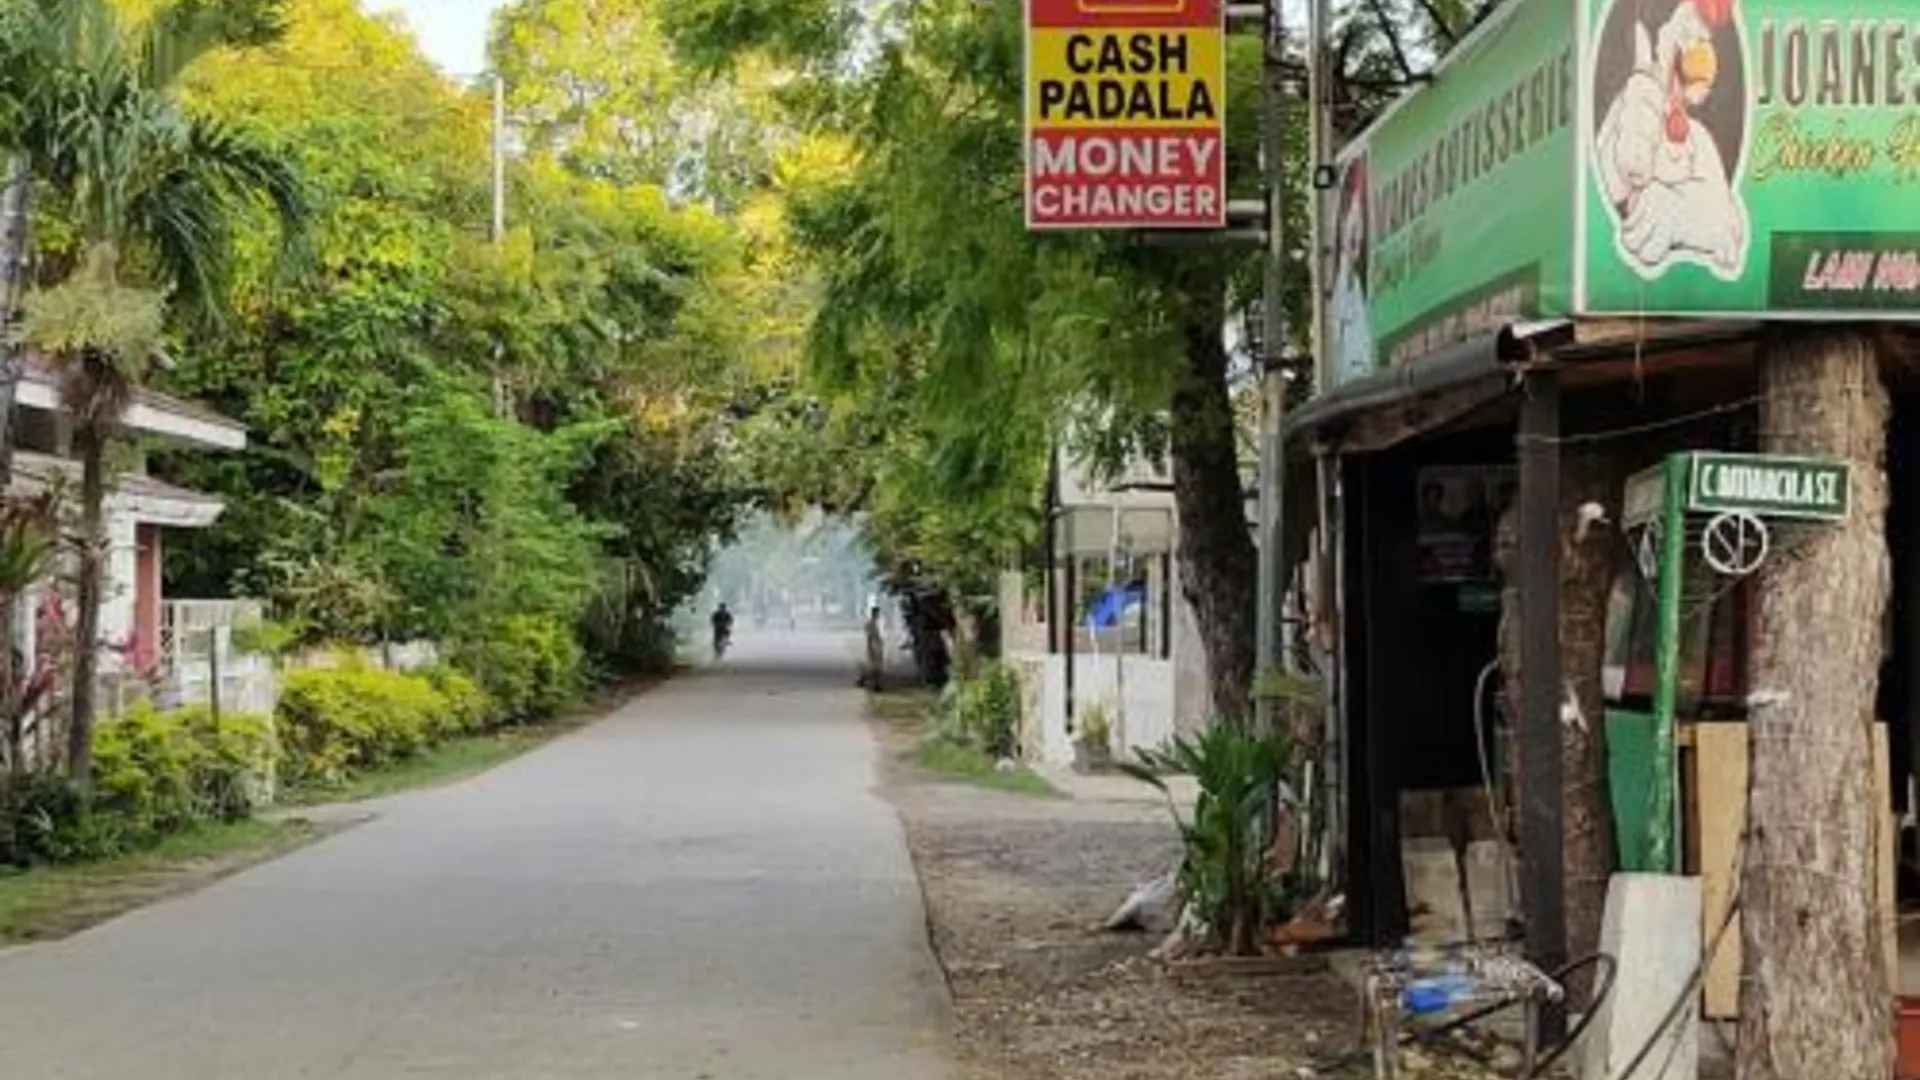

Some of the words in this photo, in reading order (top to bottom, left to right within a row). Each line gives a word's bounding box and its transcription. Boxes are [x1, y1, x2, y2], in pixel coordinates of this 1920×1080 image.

[1066, 34, 1188, 75] CASH
[1039, 80, 1216, 120] PADALA
[1034, 137, 1218, 177] MONEY
[1750, 112, 1877, 182] Chicken
[1034, 184, 1217, 216] CHANGER
